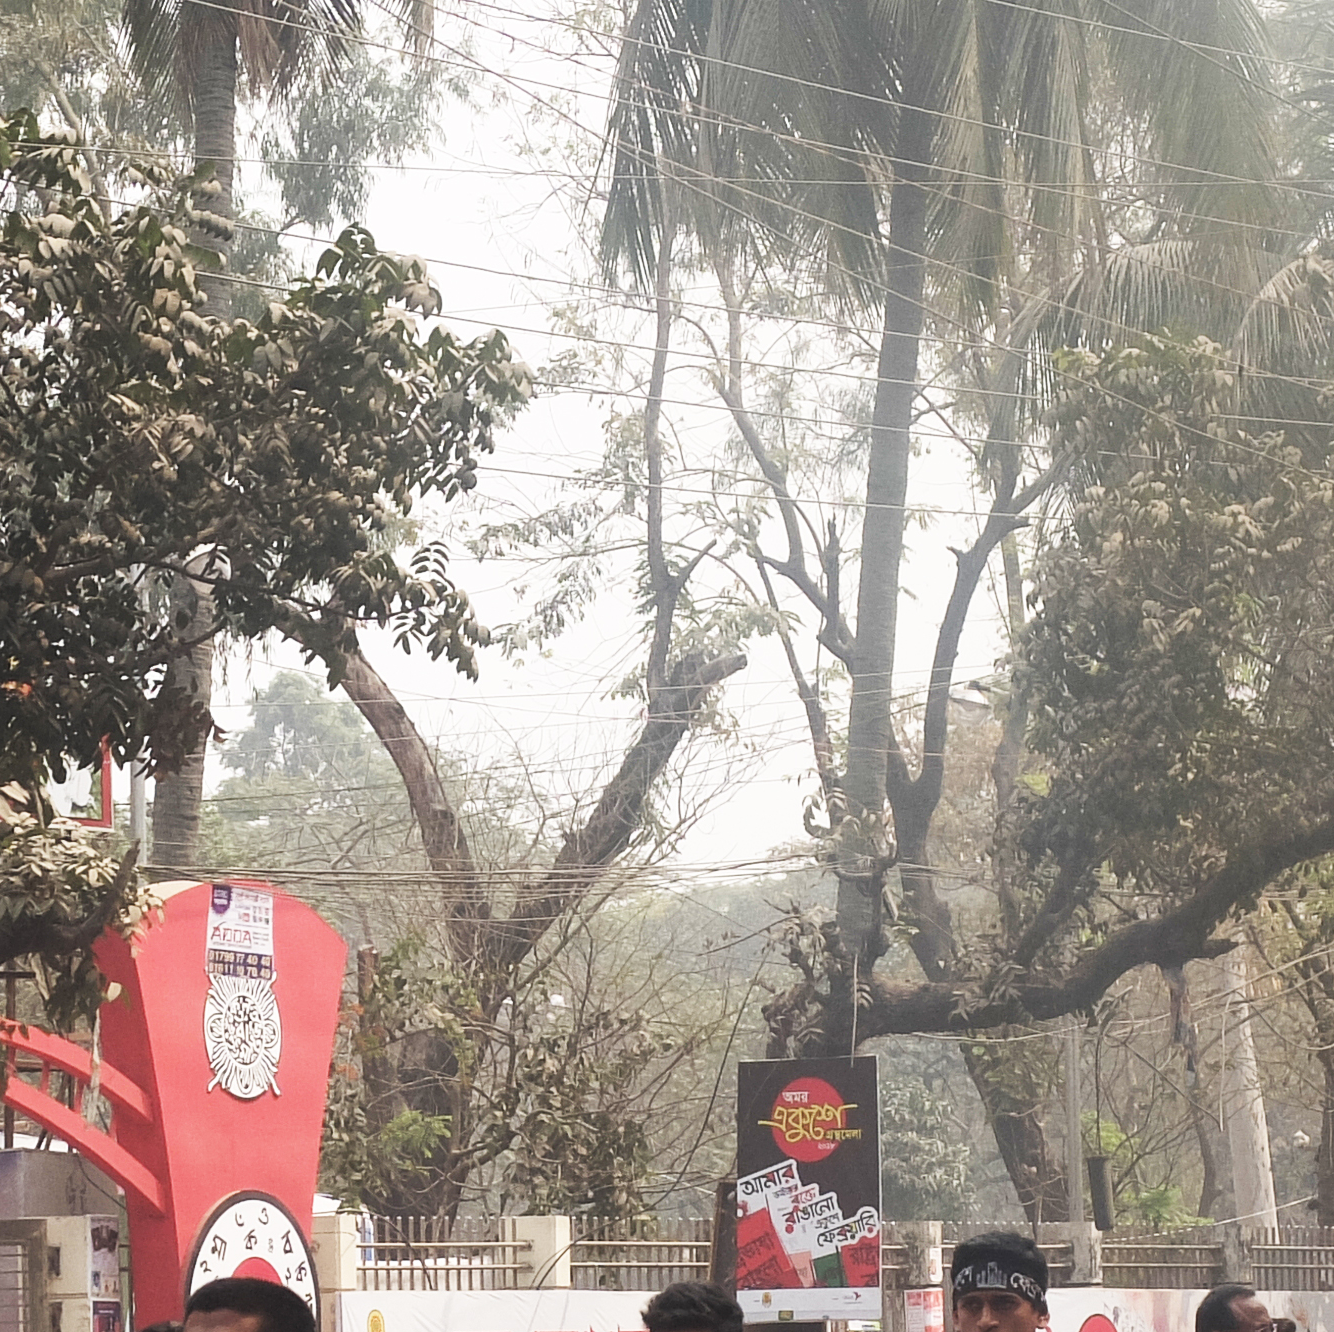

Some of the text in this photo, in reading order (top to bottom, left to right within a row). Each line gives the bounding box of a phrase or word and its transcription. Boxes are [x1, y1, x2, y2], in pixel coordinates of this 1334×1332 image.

[782, 1091, 810, 1105] অমর
[757, 1104, 858, 1143] একুশে
[739, 1163, 796, 1196] আমার
